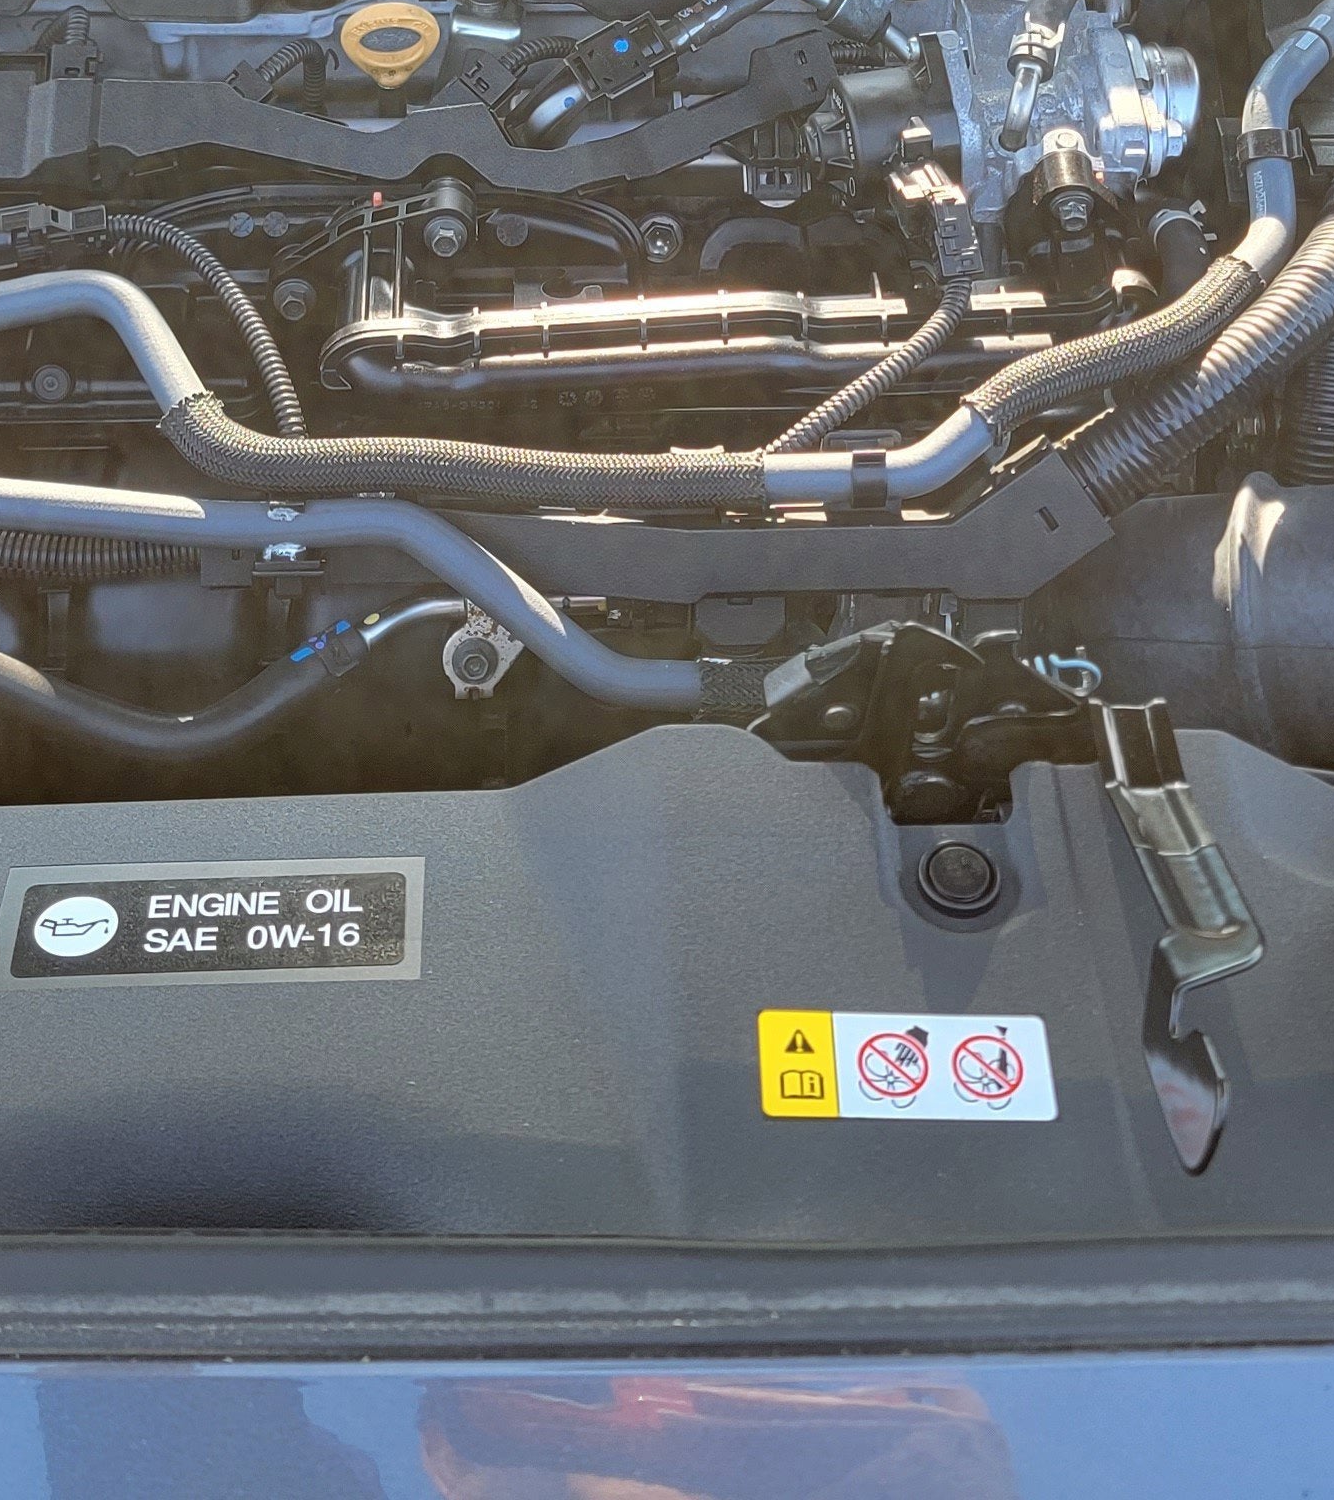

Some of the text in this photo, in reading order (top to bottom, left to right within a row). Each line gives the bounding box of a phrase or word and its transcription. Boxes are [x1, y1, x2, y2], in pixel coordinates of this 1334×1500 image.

[147, 888, 364, 919] ENGINE OIL
[143, 922, 361, 953] SAE 0W-16
